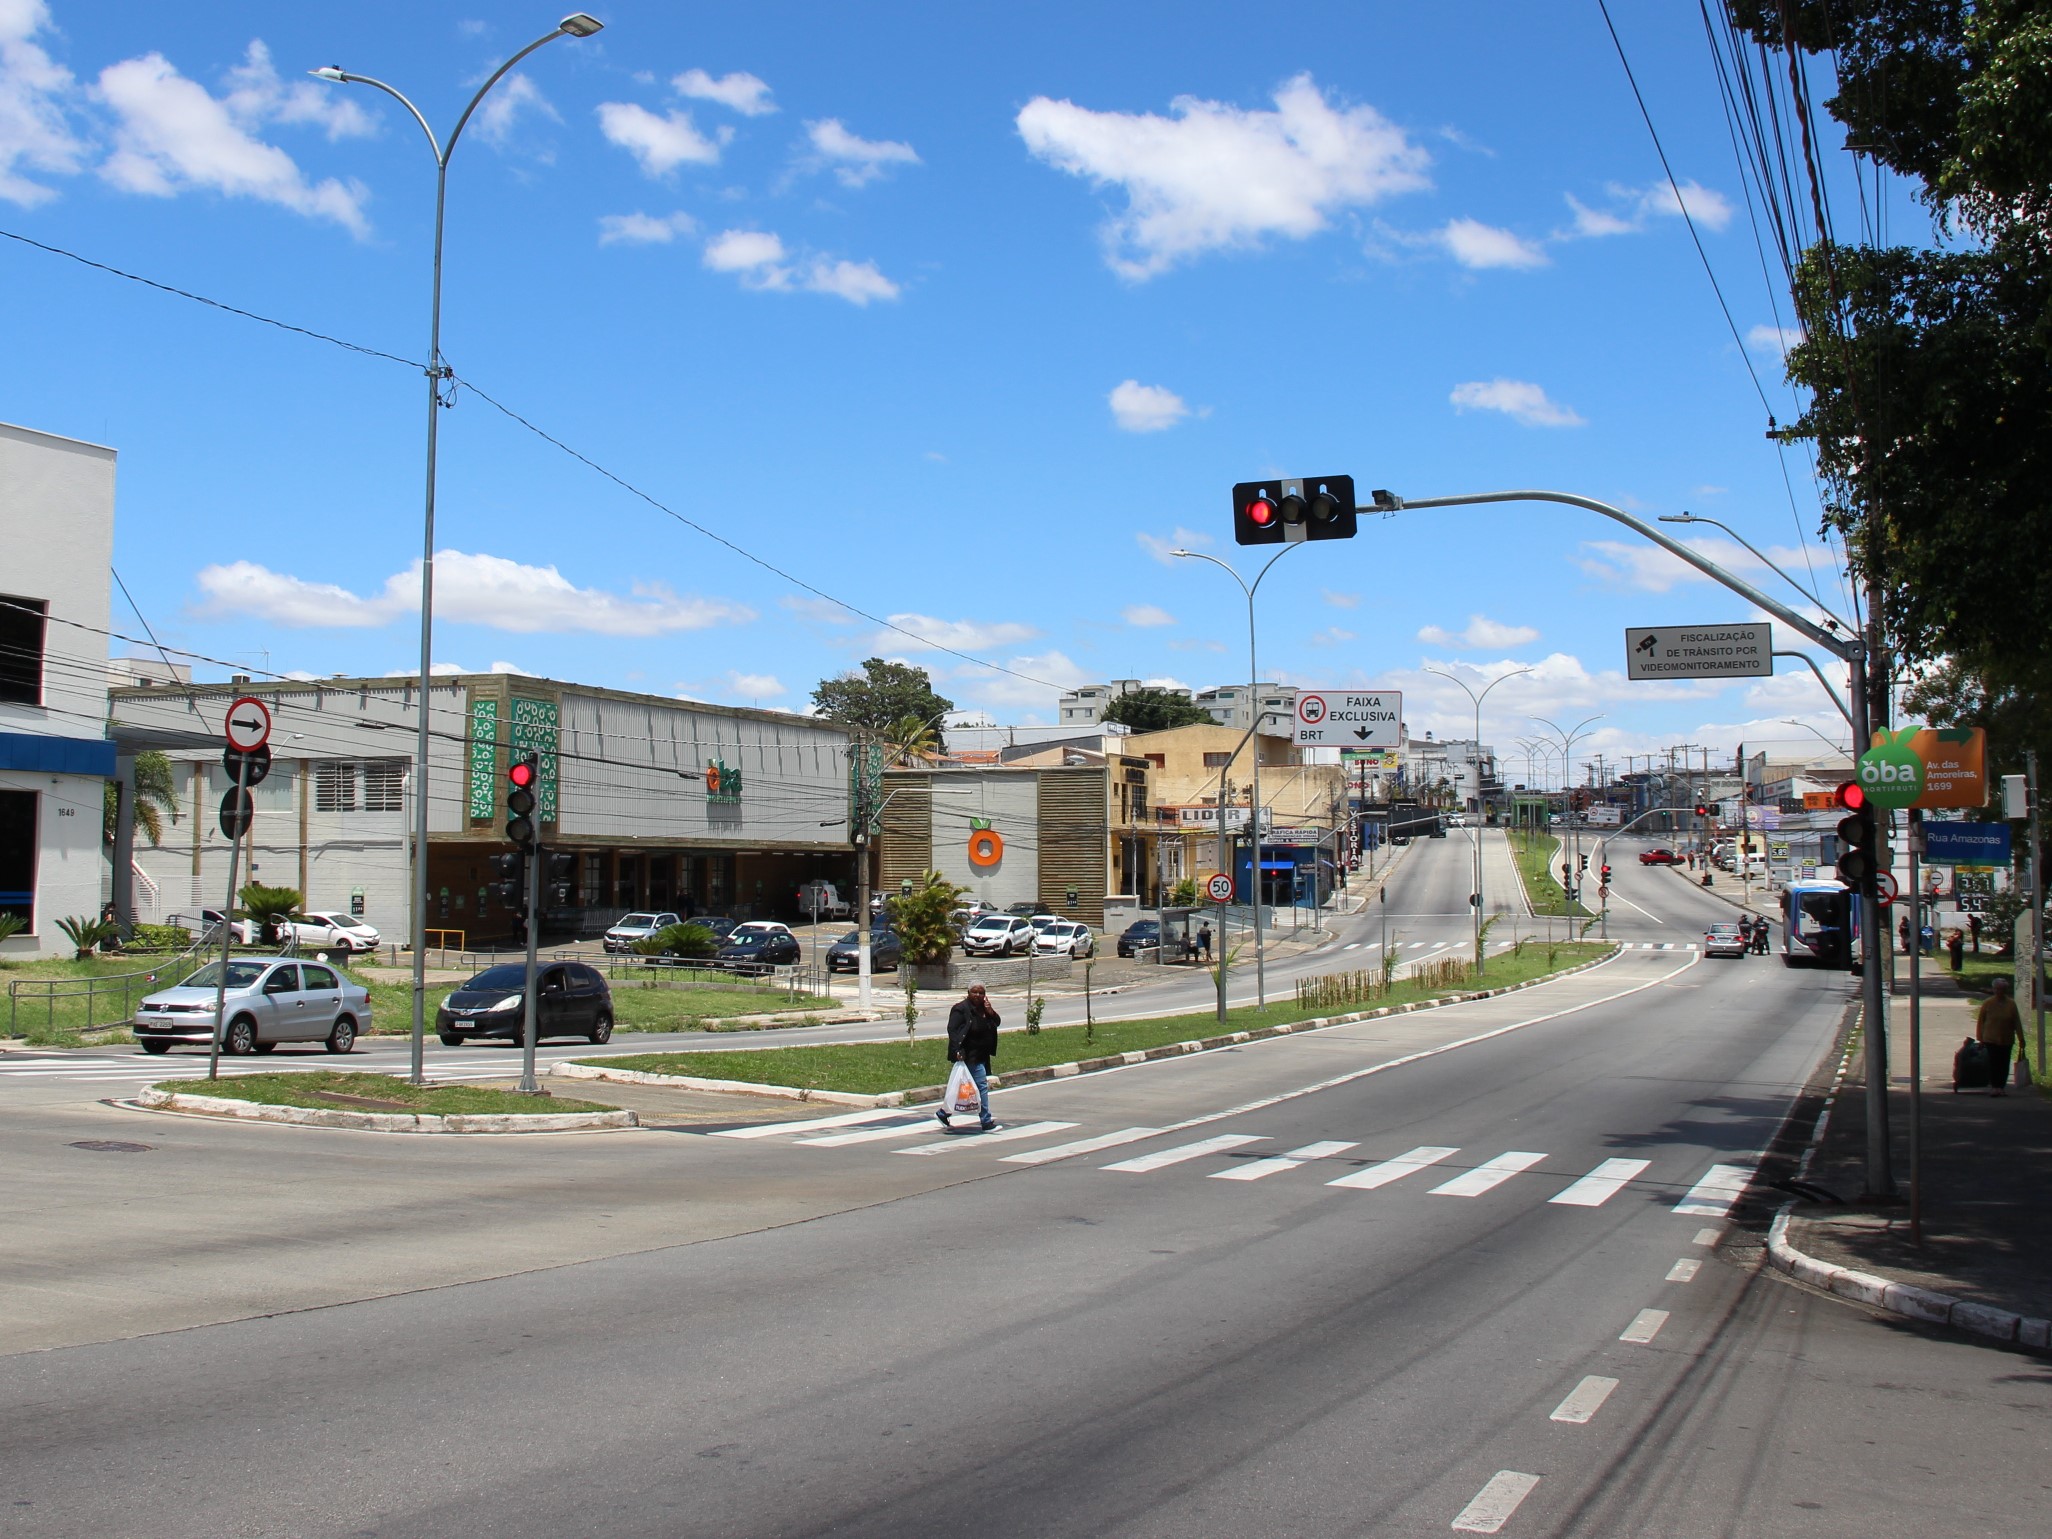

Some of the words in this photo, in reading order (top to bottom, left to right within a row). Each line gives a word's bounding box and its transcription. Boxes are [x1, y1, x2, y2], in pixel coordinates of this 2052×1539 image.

[1681, 630, 1755, 642] FISCALIZAÇÃO
[1667, 649, 1680, 657] DE
[1683, 646, 1734, 657] TRÂNSITO
[1640, 659, 1760, 672] VIDEOMONITORAMENTO
[1346, 697, 1381, 707] FAIXA
[1329, 711, 1396, 721] EXCLUSIVA
[1300, 730, 1324, 740] BRT
[1926, 761, 1940, 770] Av.
[1942, 760, 1959, 769] das
[1926, 770, 1978, 780] Amoreiras,
[1862, 785, 1918, 793] HORTIFRUTI
[1927, 782, 1952, 791] 1699
[58, 808, 75, 817] 1649
[1349, 810, 1358, 861] VSTORIA
[1927, 832, 1948, 842] Rua
[1950, 833, 2001, 845] Amazonas
[1212, 880, 1229, 893] 50
